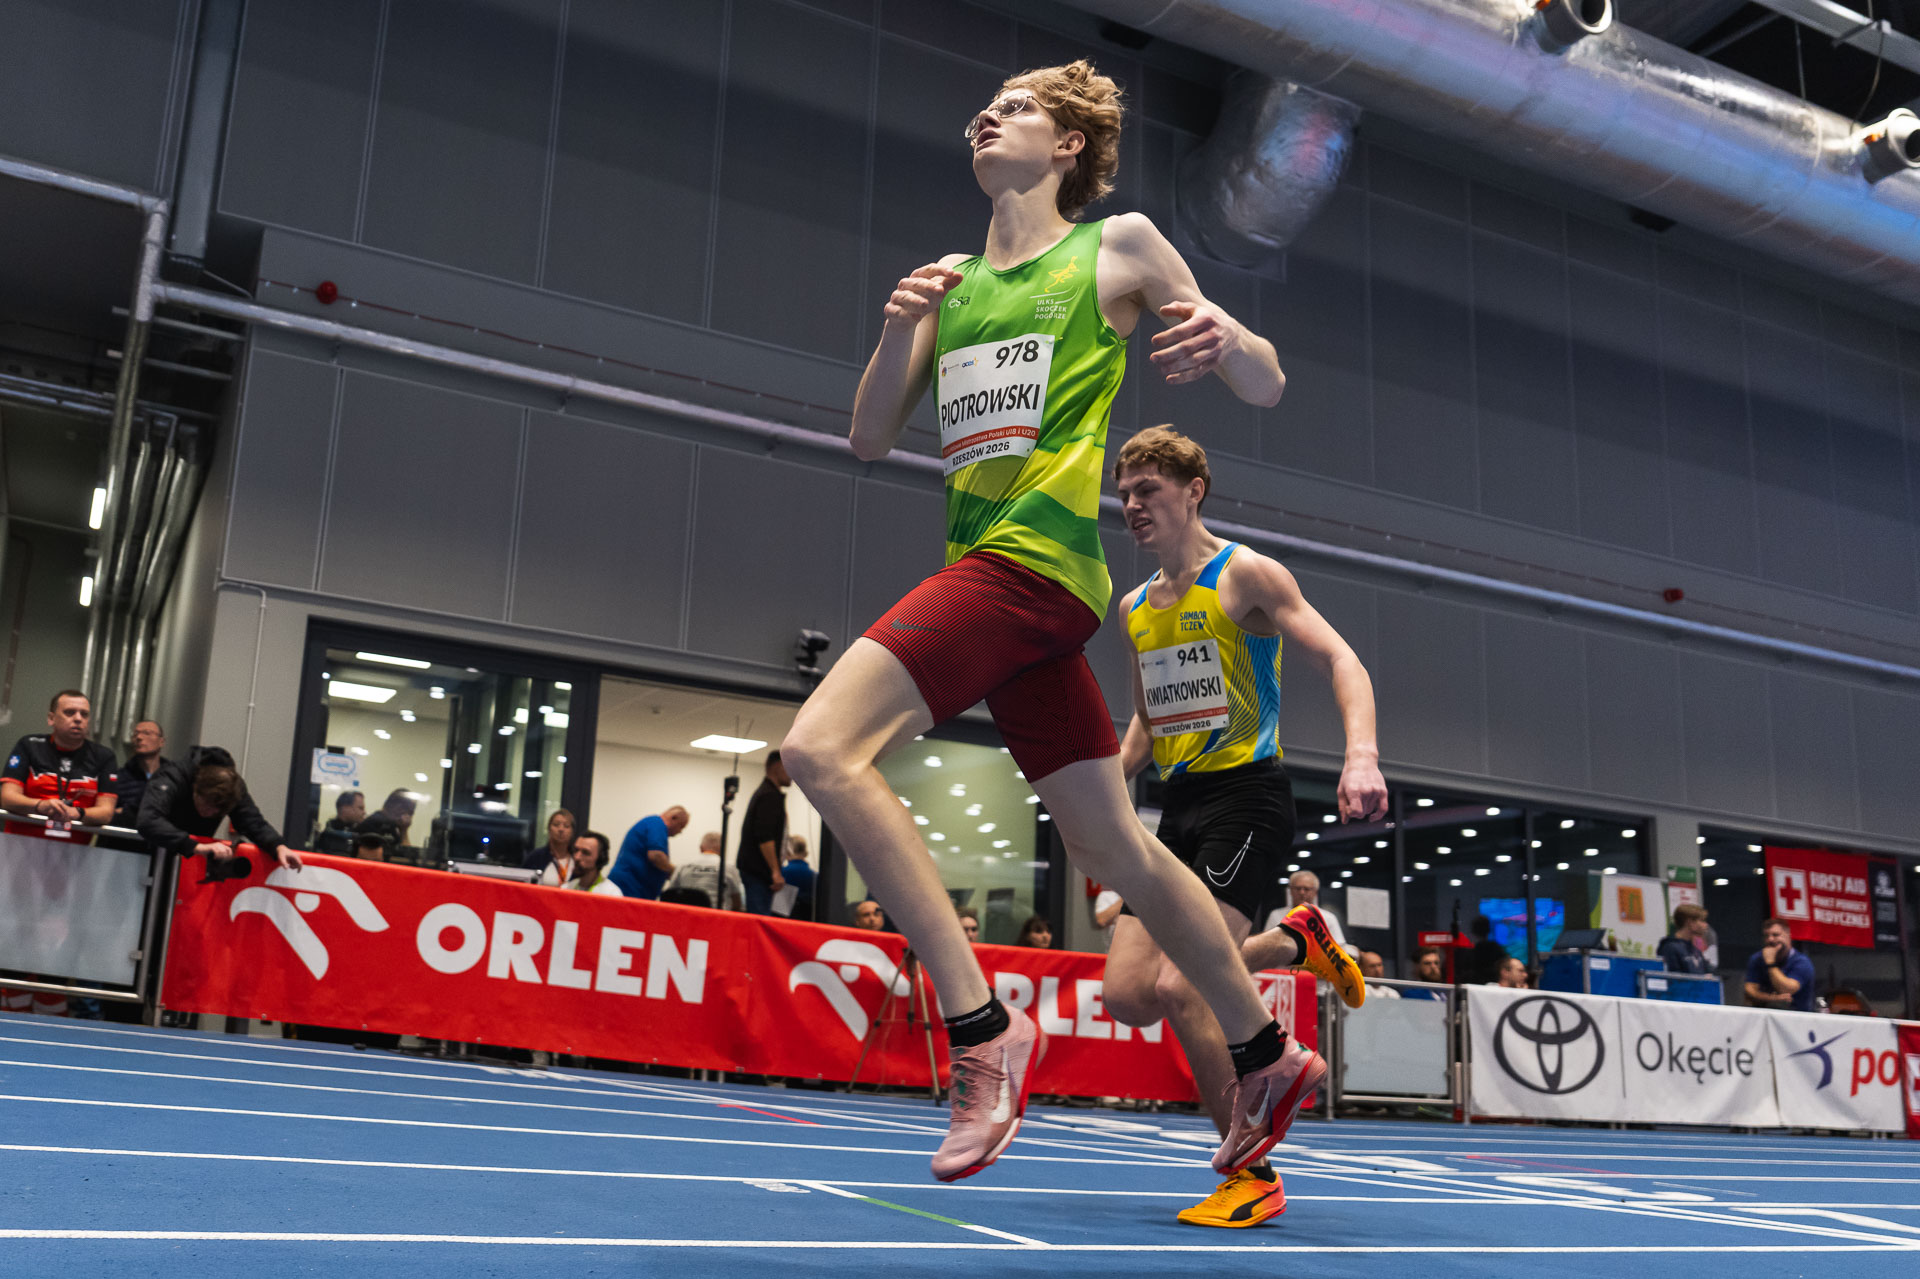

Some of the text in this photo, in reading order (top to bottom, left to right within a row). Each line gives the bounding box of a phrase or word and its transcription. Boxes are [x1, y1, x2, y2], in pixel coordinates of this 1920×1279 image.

[1036, 305, 1067, 313] SKOCZEK
[994, 339, 1039, 369] 978
[941, 383, 1040, 431] PIOTROWSKI
[988, 430, 1005, 439] Polski
[1005, 427, 1017, 436] U18
[1021, 428, 1036, 437] U20
[952, 441, 1010, 466] RZESZÓW 2026
[1180, 611, 1207, 621] SAMBOR
[1181, 621, 1206, 632] TCZEW
[1177, 645, 1212, 667] 941
[1146, 675, 1222, 707] KWIATKOWSKI
[1162, 719, 1211, 734] RZESZÓW 2026
[1845, 877, 1867, 895] AID
[416, 903, 709, 1004] ORLEN
[936, 971, 1164, 1043] RLE
[1636, 1031, 1754, 1085] Okęcie
